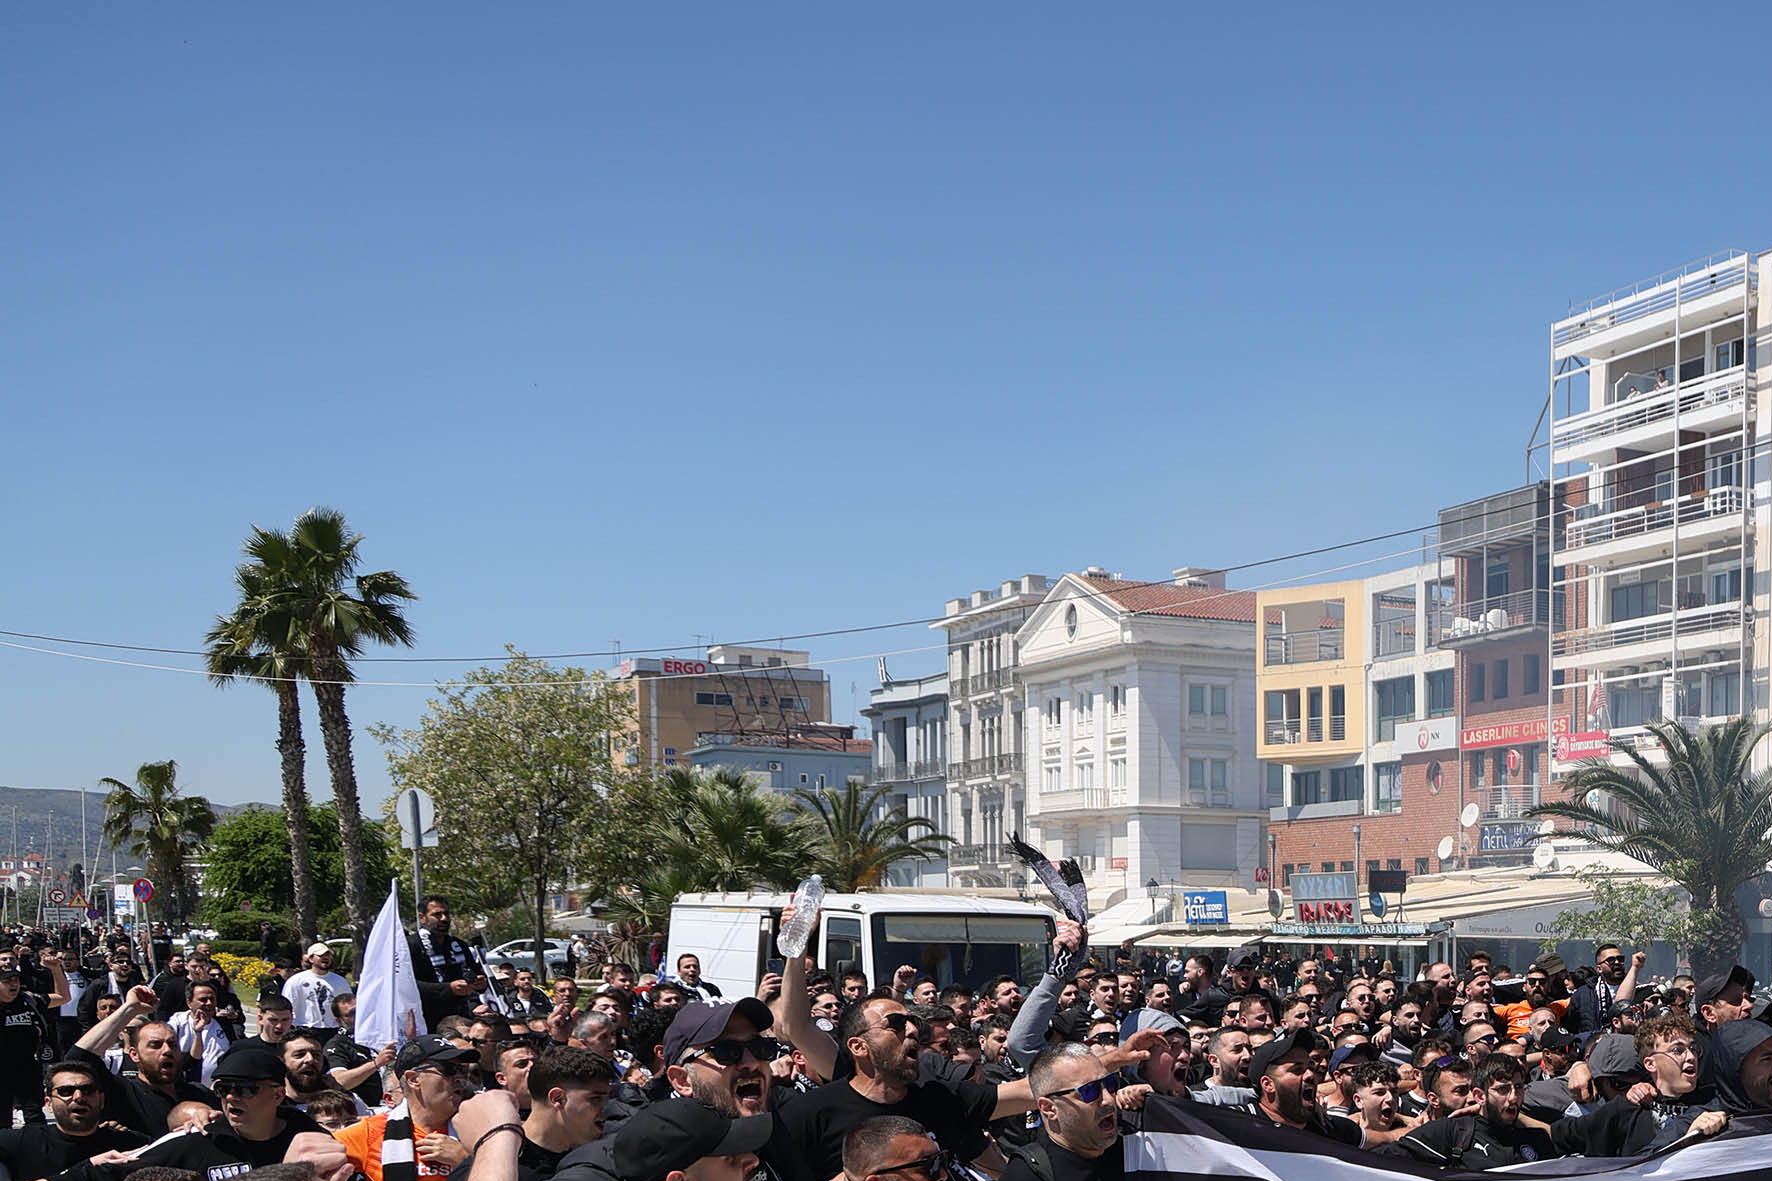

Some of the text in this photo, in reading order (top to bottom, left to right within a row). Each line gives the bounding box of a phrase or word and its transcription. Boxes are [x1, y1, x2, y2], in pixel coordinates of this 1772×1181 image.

[663, 660, 705, 675] ERGO
[1430, 730, 1440, 741] NN
[1463, 718, 1567, 745] LASERLINE CLINCS
